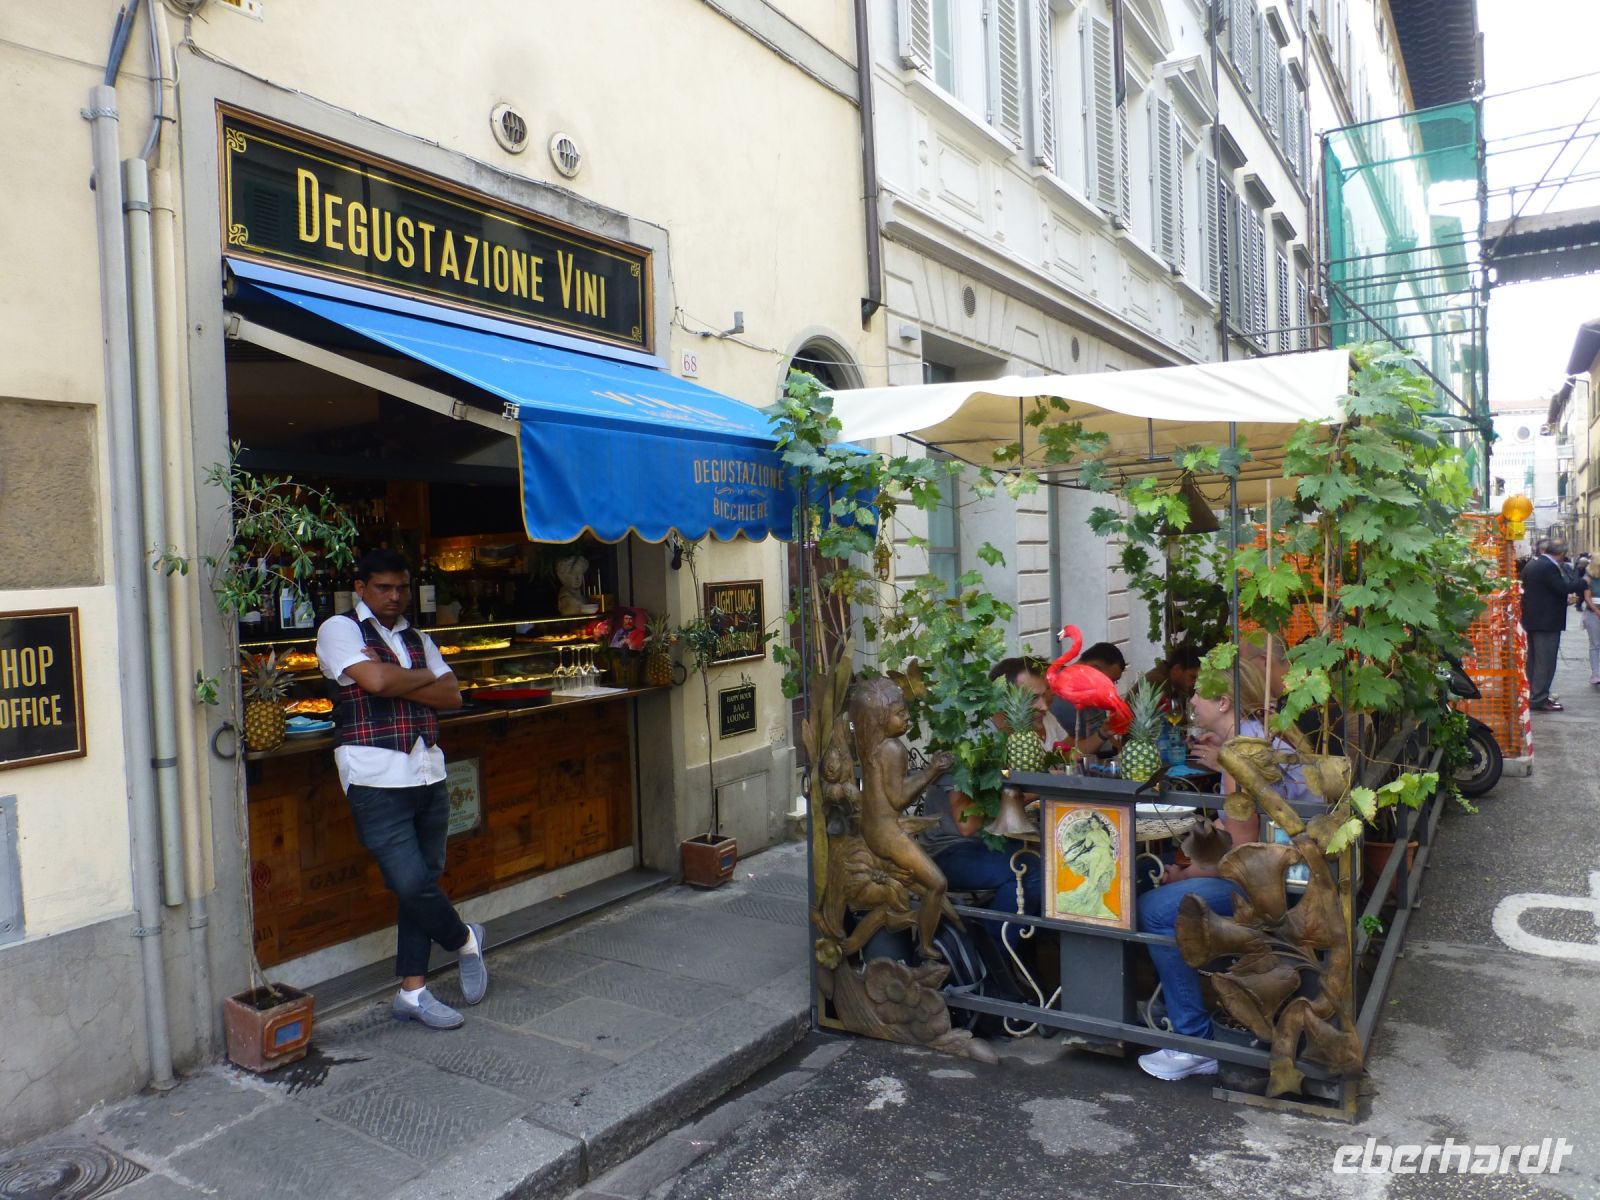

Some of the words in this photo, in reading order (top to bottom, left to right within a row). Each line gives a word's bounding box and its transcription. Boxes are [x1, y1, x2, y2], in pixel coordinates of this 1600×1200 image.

[683, 353, 698, 373] 68
[693, 459, 785, 491] DEGUSTAZIONE
[733, 703, 745, 713] BAR
[727, 711, 750, 724] LOUNGE
